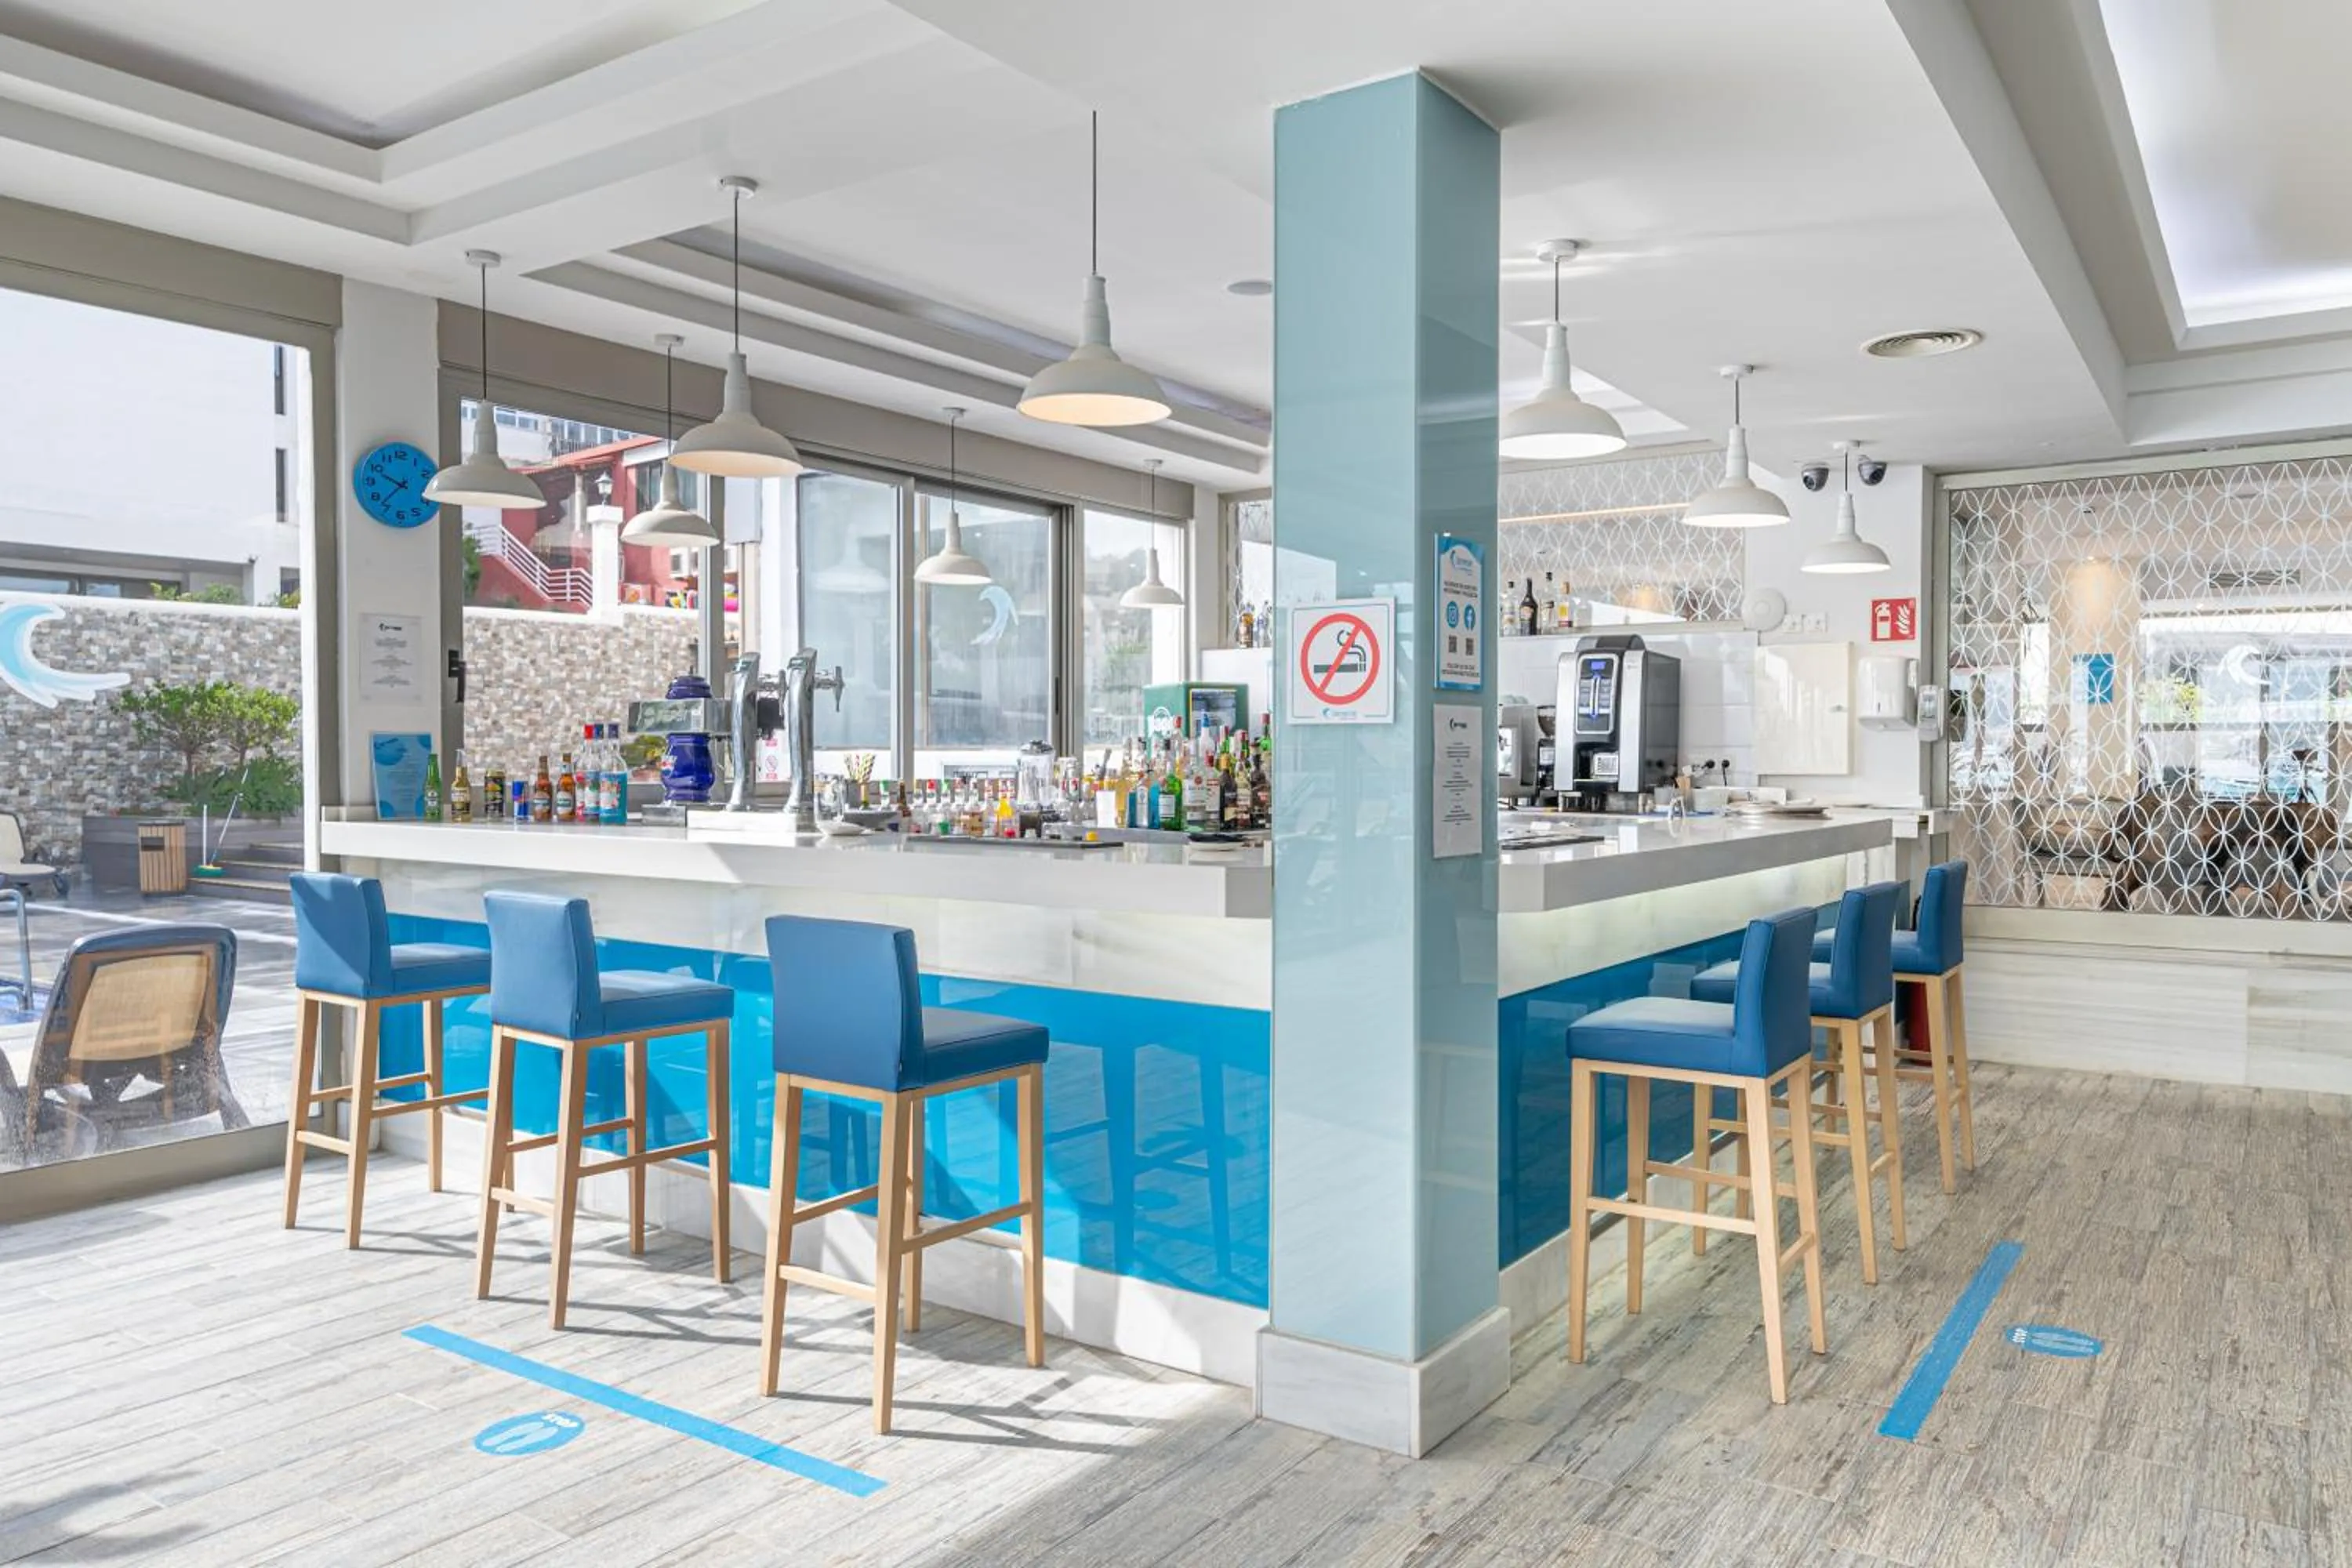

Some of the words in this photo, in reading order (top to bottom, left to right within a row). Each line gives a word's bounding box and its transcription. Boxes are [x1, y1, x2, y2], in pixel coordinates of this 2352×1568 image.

[382, 453, 392, 463] 11
[394, 451, 408, 461] 12
[371, 463, 383, 474] 10
